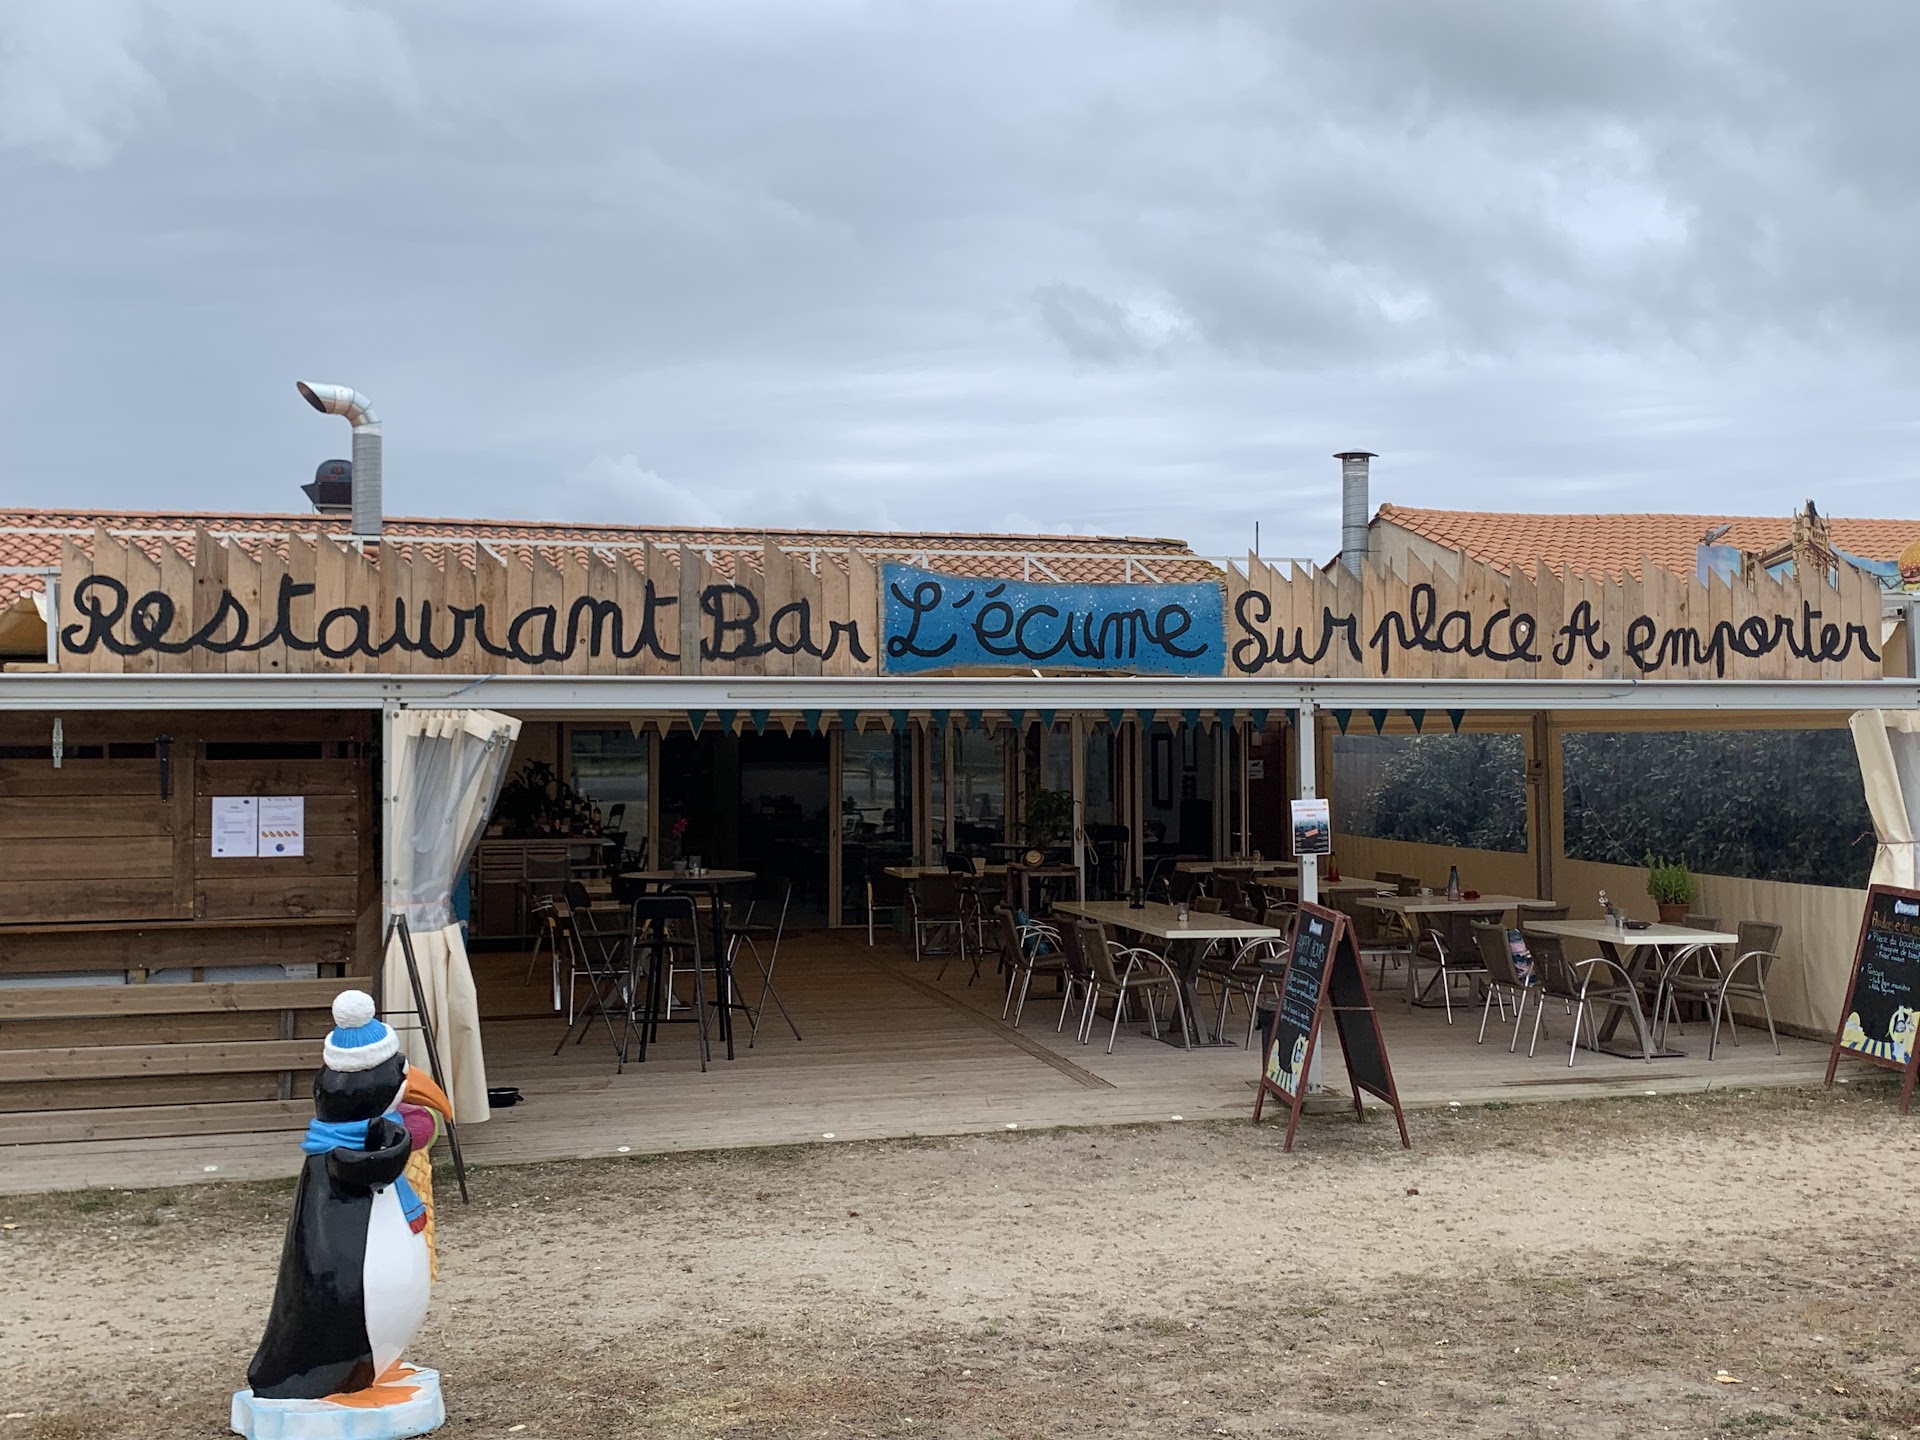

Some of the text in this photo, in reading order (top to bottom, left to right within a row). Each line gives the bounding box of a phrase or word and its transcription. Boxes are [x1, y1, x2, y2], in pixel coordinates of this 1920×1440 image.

[61, 573, 873, 665] Restaurant Bar
[887, 581, 1209, 661] L'écume
[1232, 582, 1881, 678] Sur place A emporter
